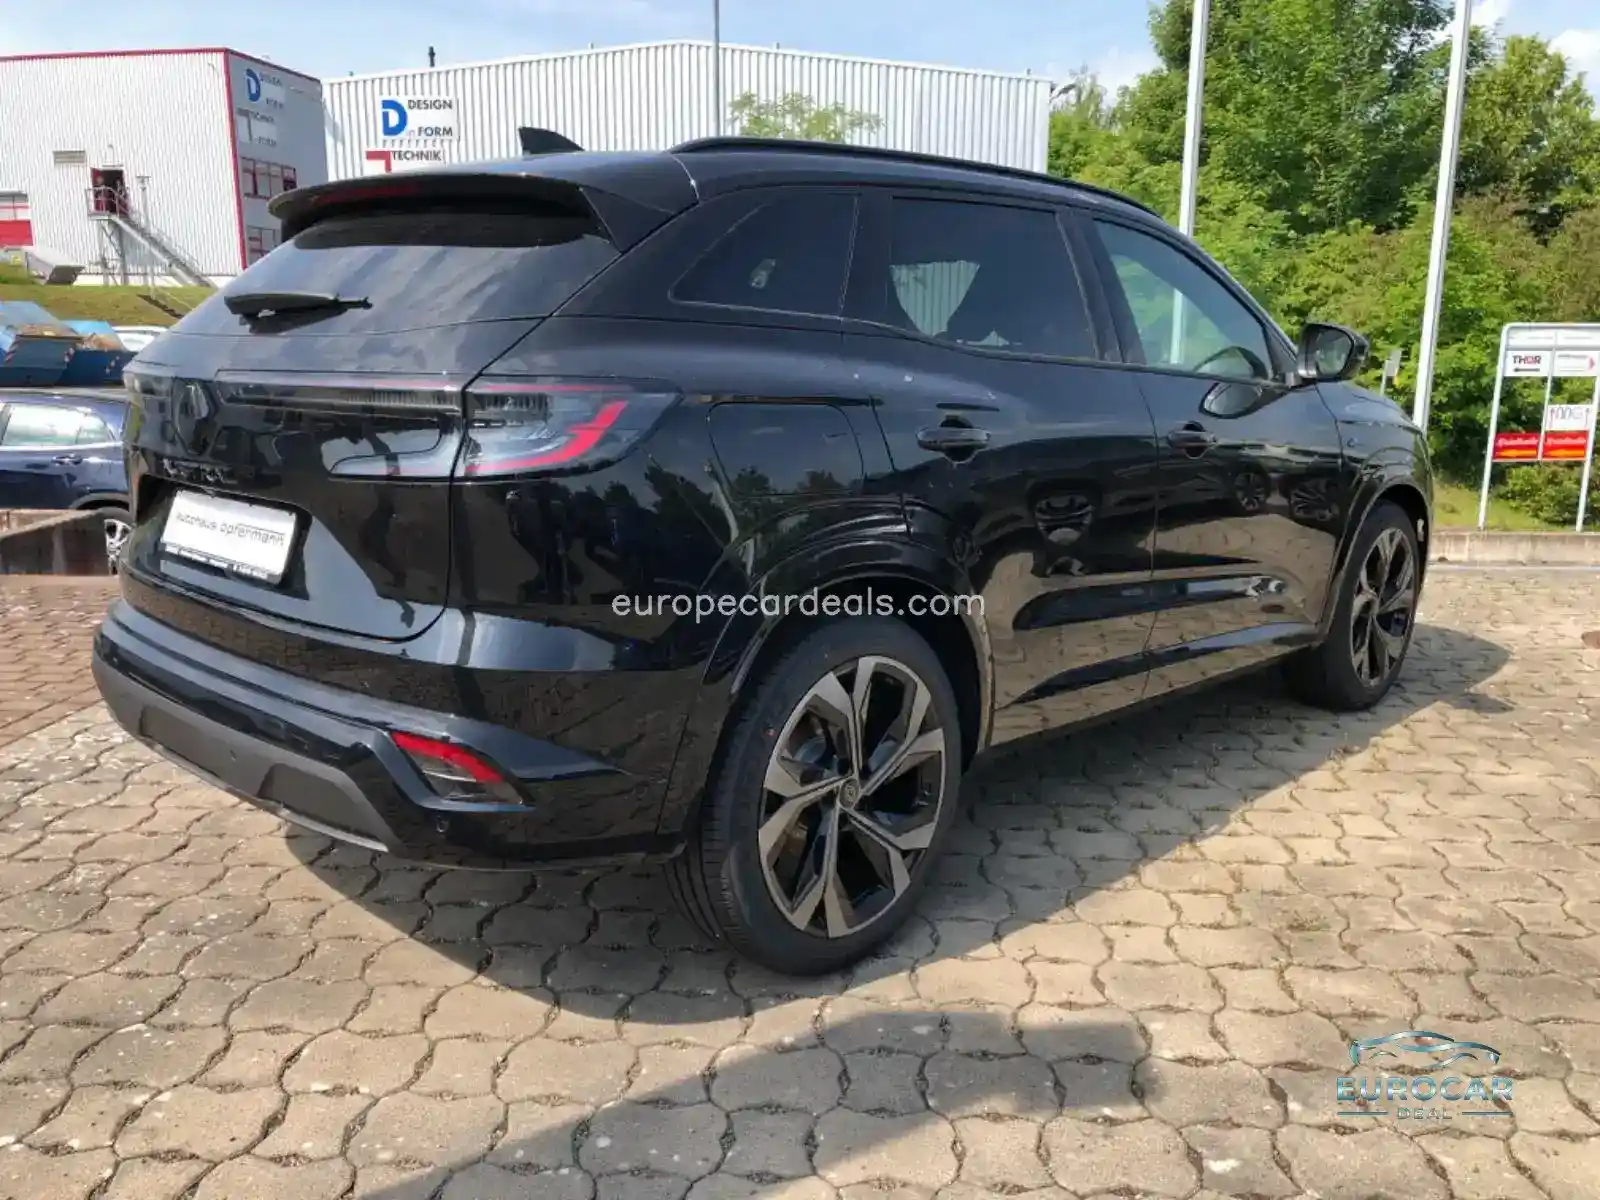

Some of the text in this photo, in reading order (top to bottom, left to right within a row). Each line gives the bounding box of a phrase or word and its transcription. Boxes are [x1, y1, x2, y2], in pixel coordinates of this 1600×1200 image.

[407, 99, 453, 110] DESIGN
[381, 99, 408, 136] D
[417, 126, 453, 137] FORM
[391, 150, 442, 161] TECHNIK
[1512, 355, 1541, 365] THOR
